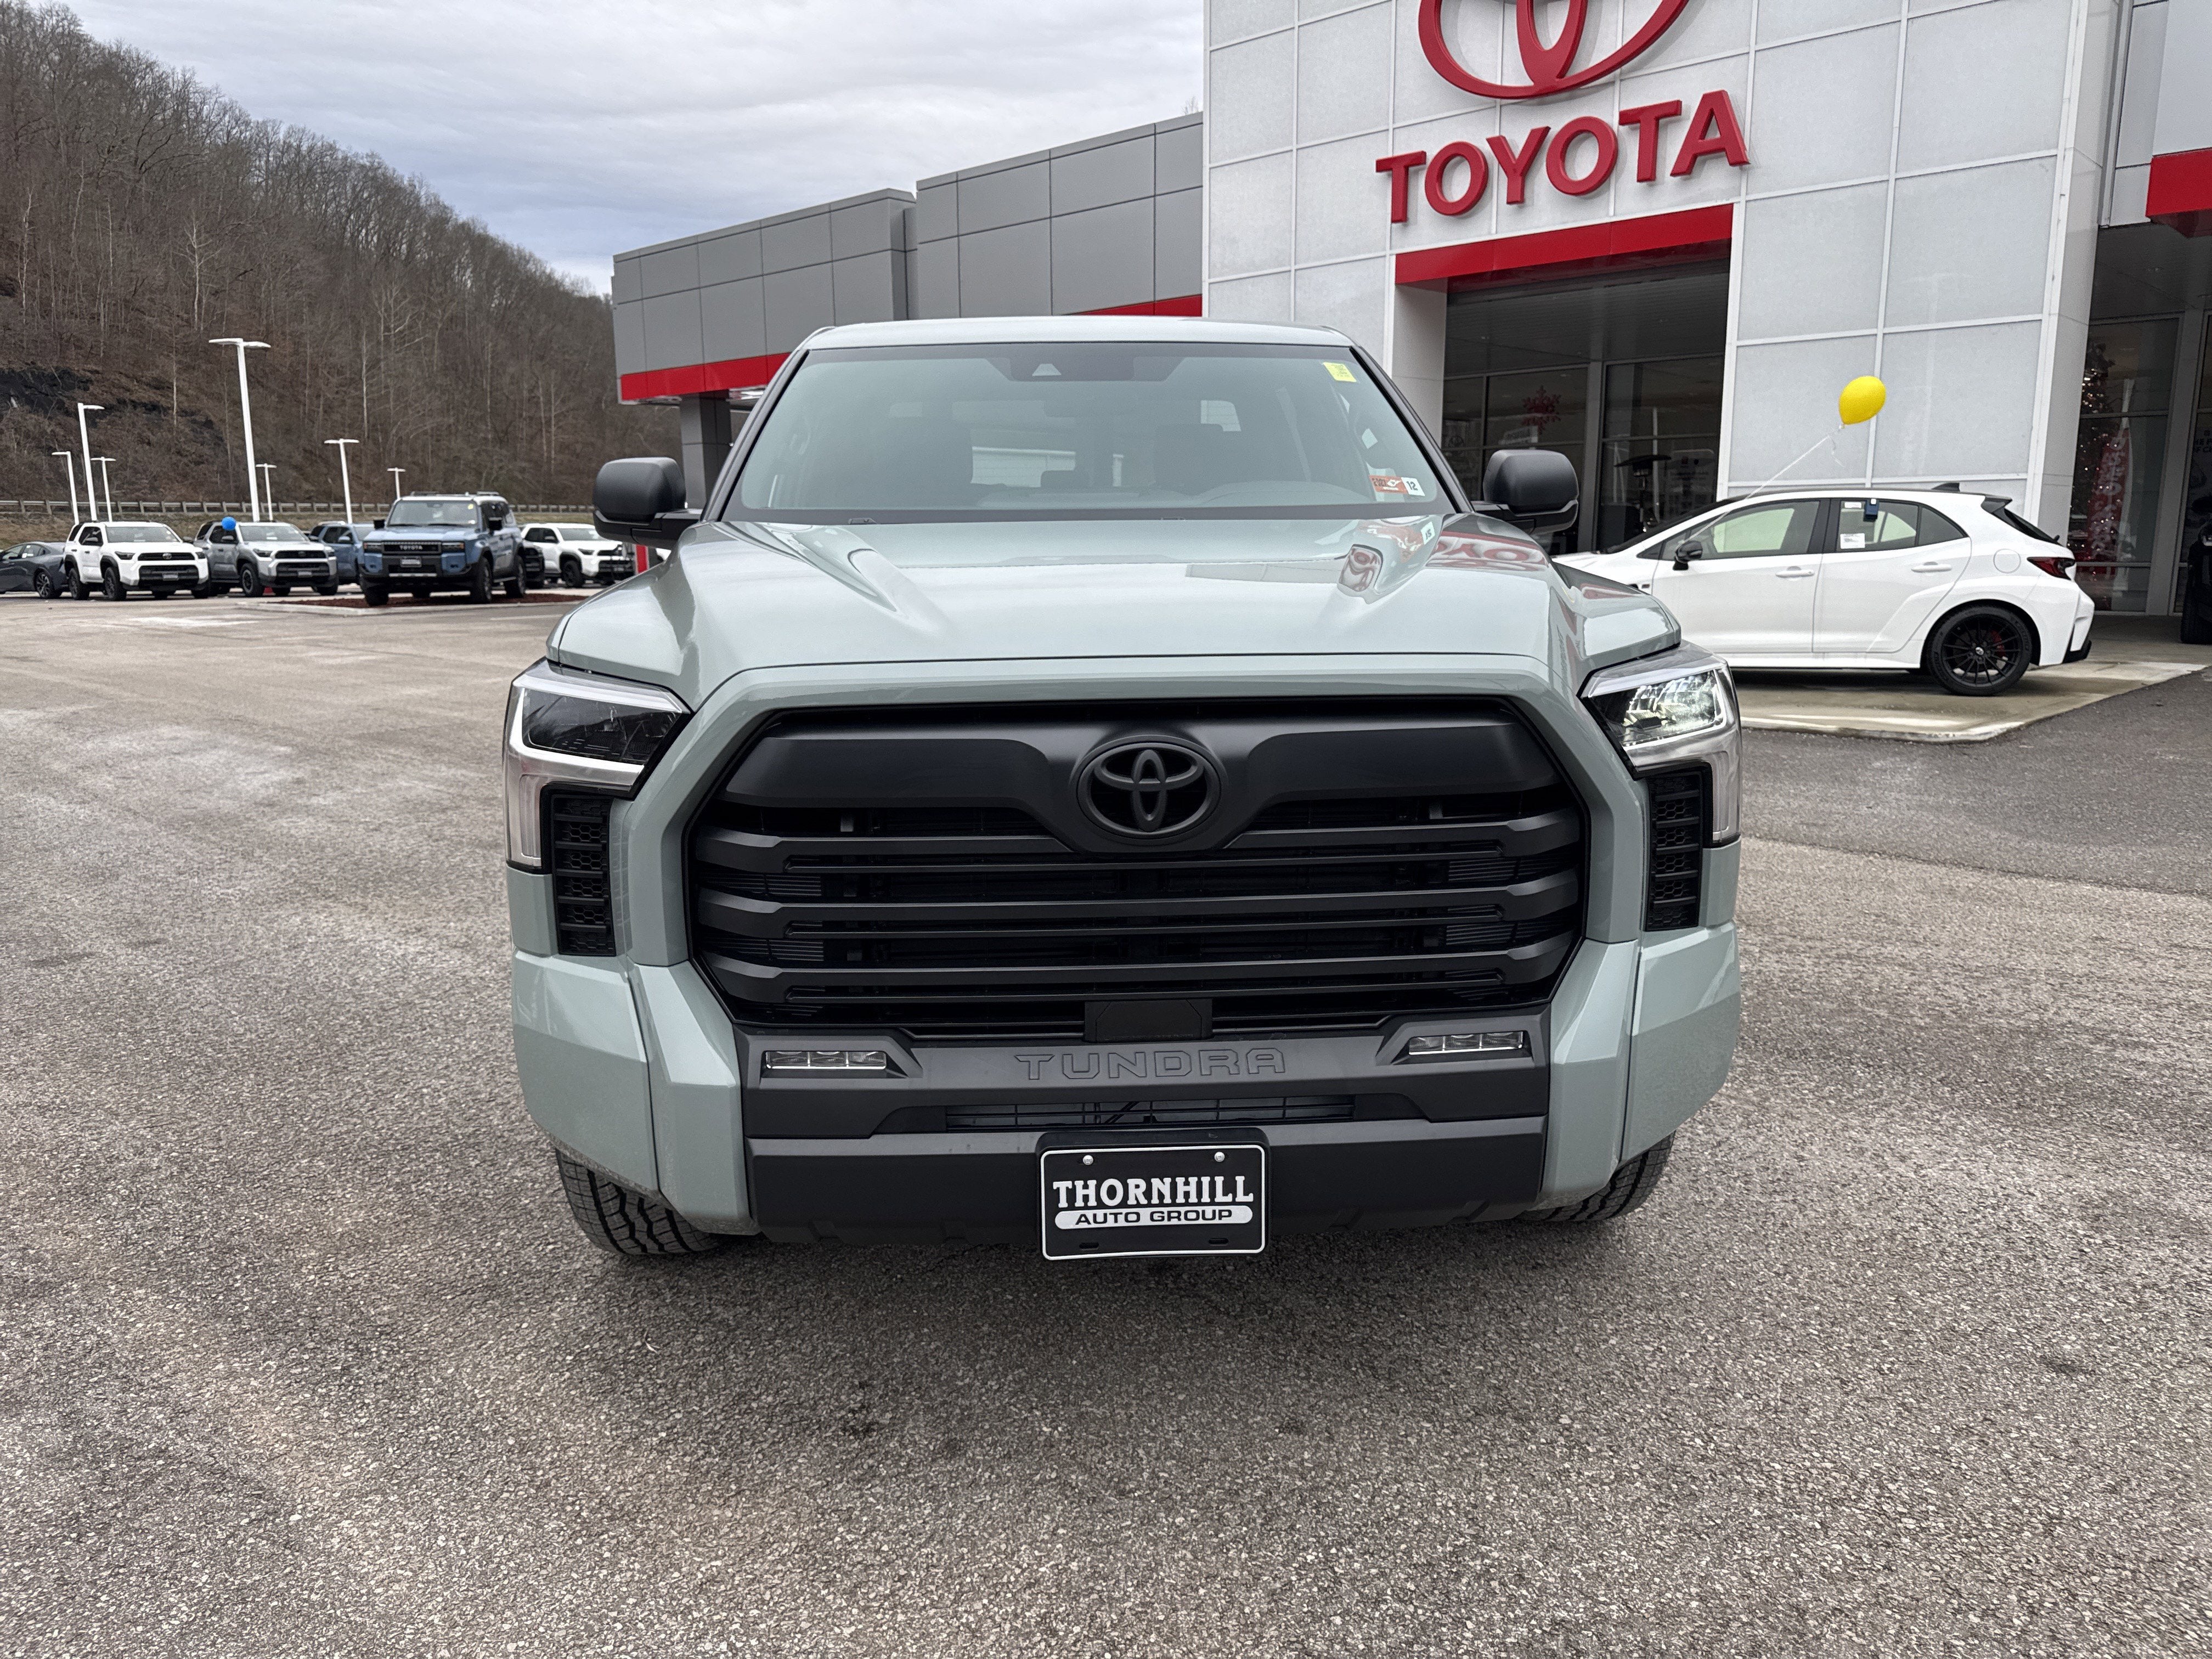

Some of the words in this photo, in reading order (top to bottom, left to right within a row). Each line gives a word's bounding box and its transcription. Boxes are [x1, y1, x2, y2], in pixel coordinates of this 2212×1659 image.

[1376, 89, 1750, 223] TOYOTA
[1406, 481, 1418, 490] 12
[1014, 1048, 1285, 1080] TUNDRA
[1052, 1176, 1254, 1208] THORNHILL
[1075, 1211, 1141, 1225] AUTO
[1150, 1209, 1232, 1222] GROUP
